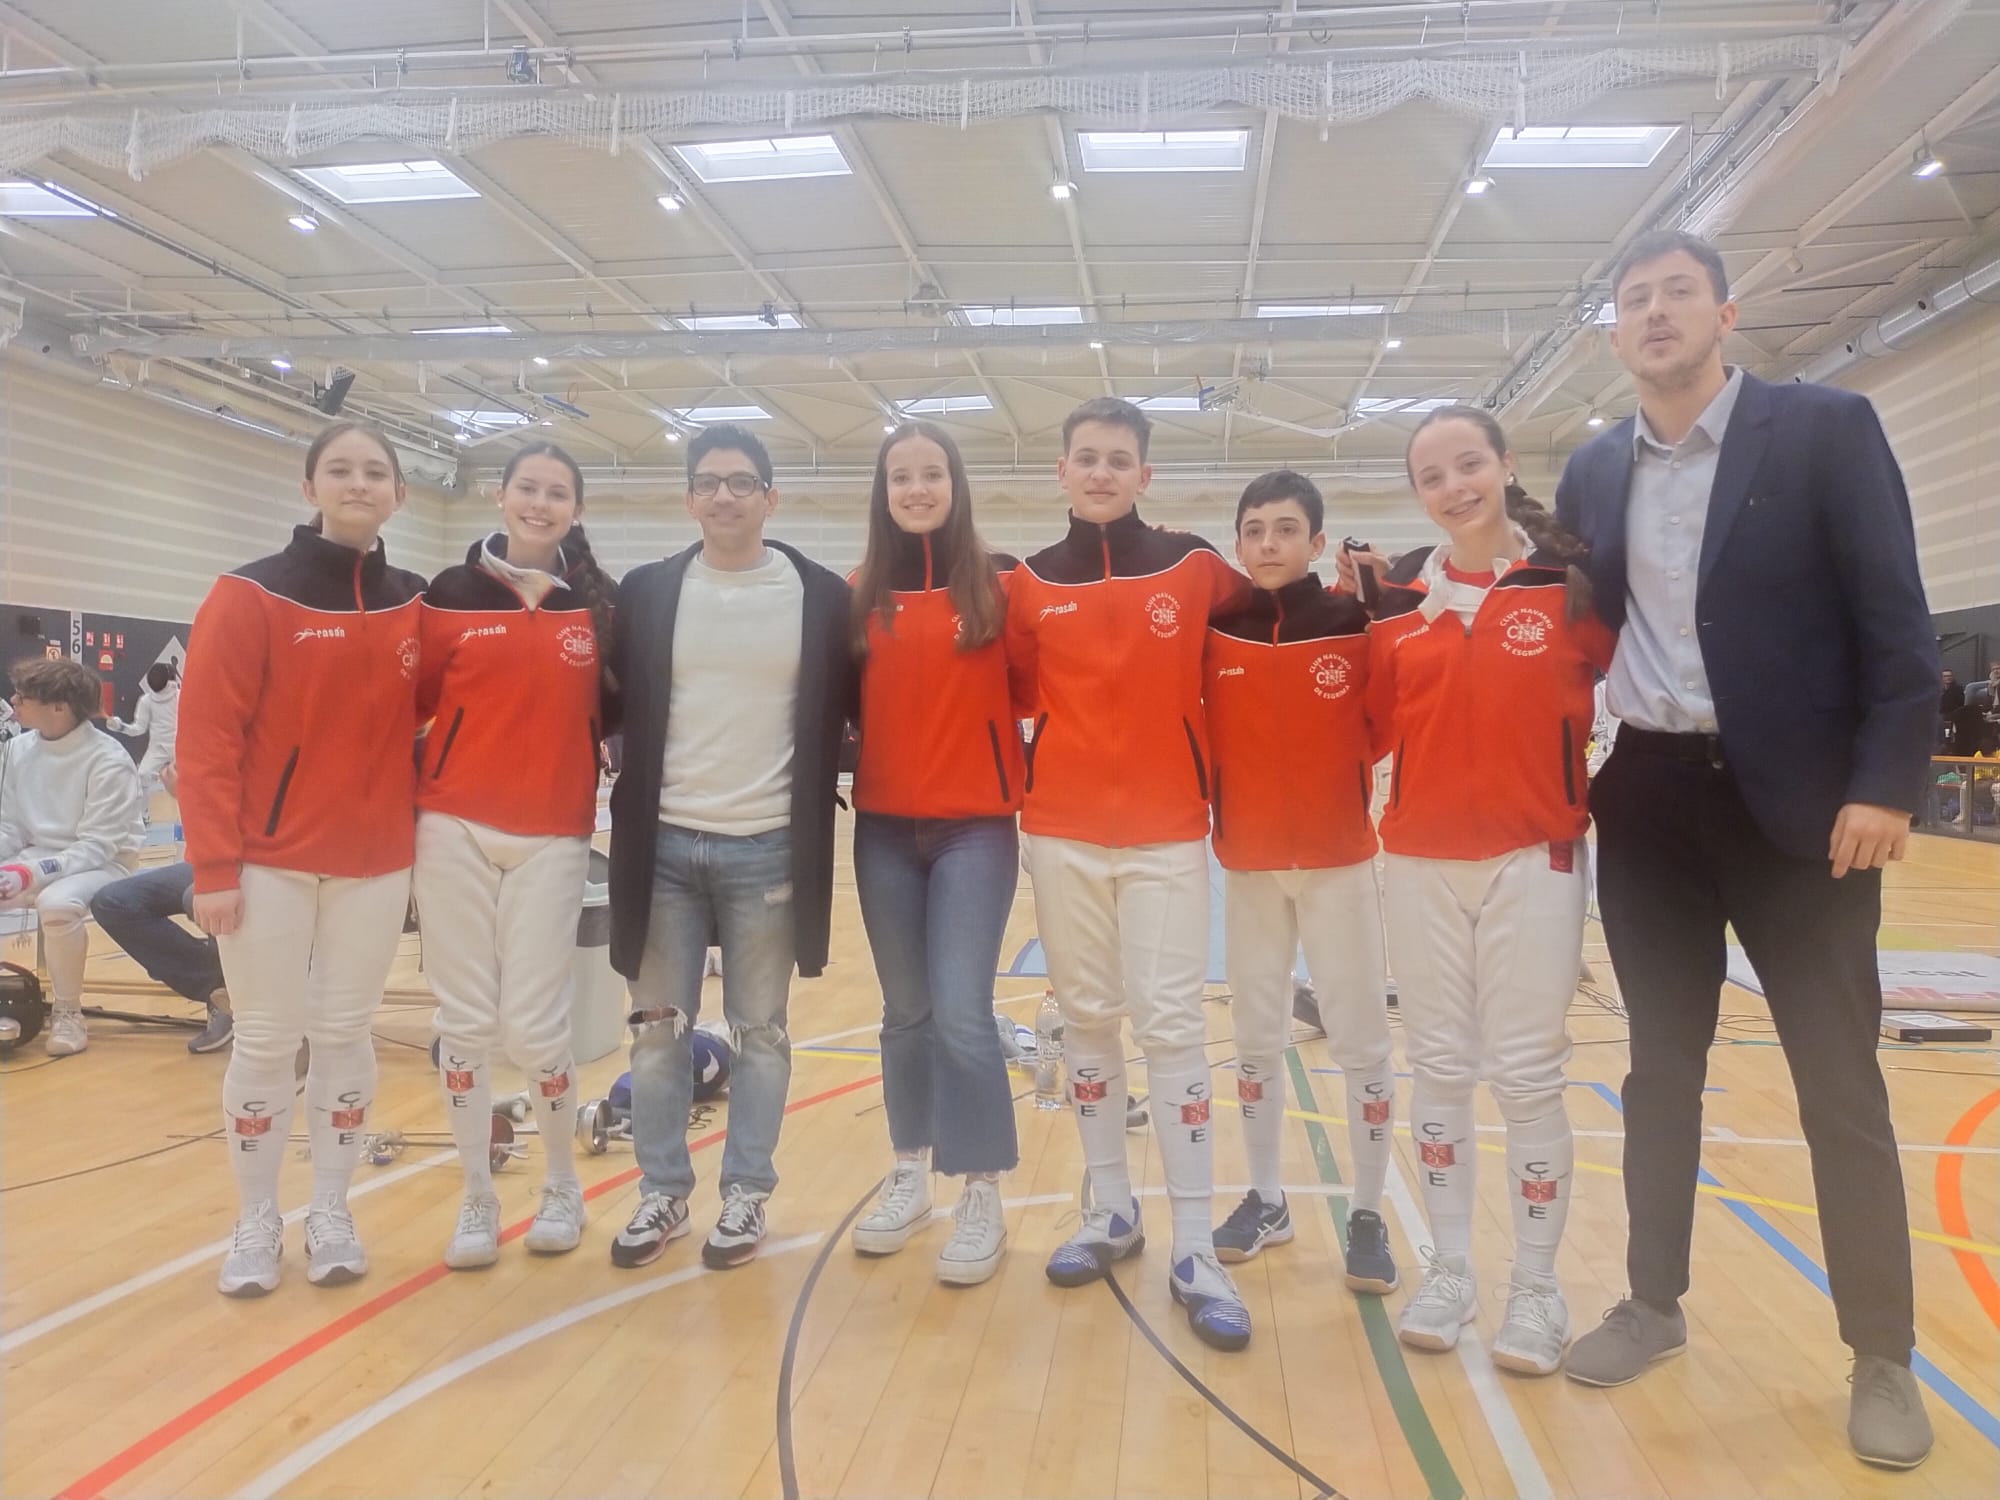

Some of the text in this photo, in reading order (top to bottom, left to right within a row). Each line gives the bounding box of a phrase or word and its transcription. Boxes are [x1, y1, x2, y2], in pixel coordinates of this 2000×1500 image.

[72, 620, 81, 636] 5
[72, 638, 81, 654] 6
[452, 1095, 468, 1108] E
[551, 1098, 566, 1112] E
[1081, 1104, 1097, 1117] E
[1243, 1104, 1257, 1119] E
[339, 1132, 355, 1145] E
[1190, 1128, 1207, 1143] E
[1369, 1128, 1384, 1142] E
[240, 1138, 258, 1152] E
[1428, 1171, 1449, 1187] E
[1528, 1205, 1549, 1219] E
